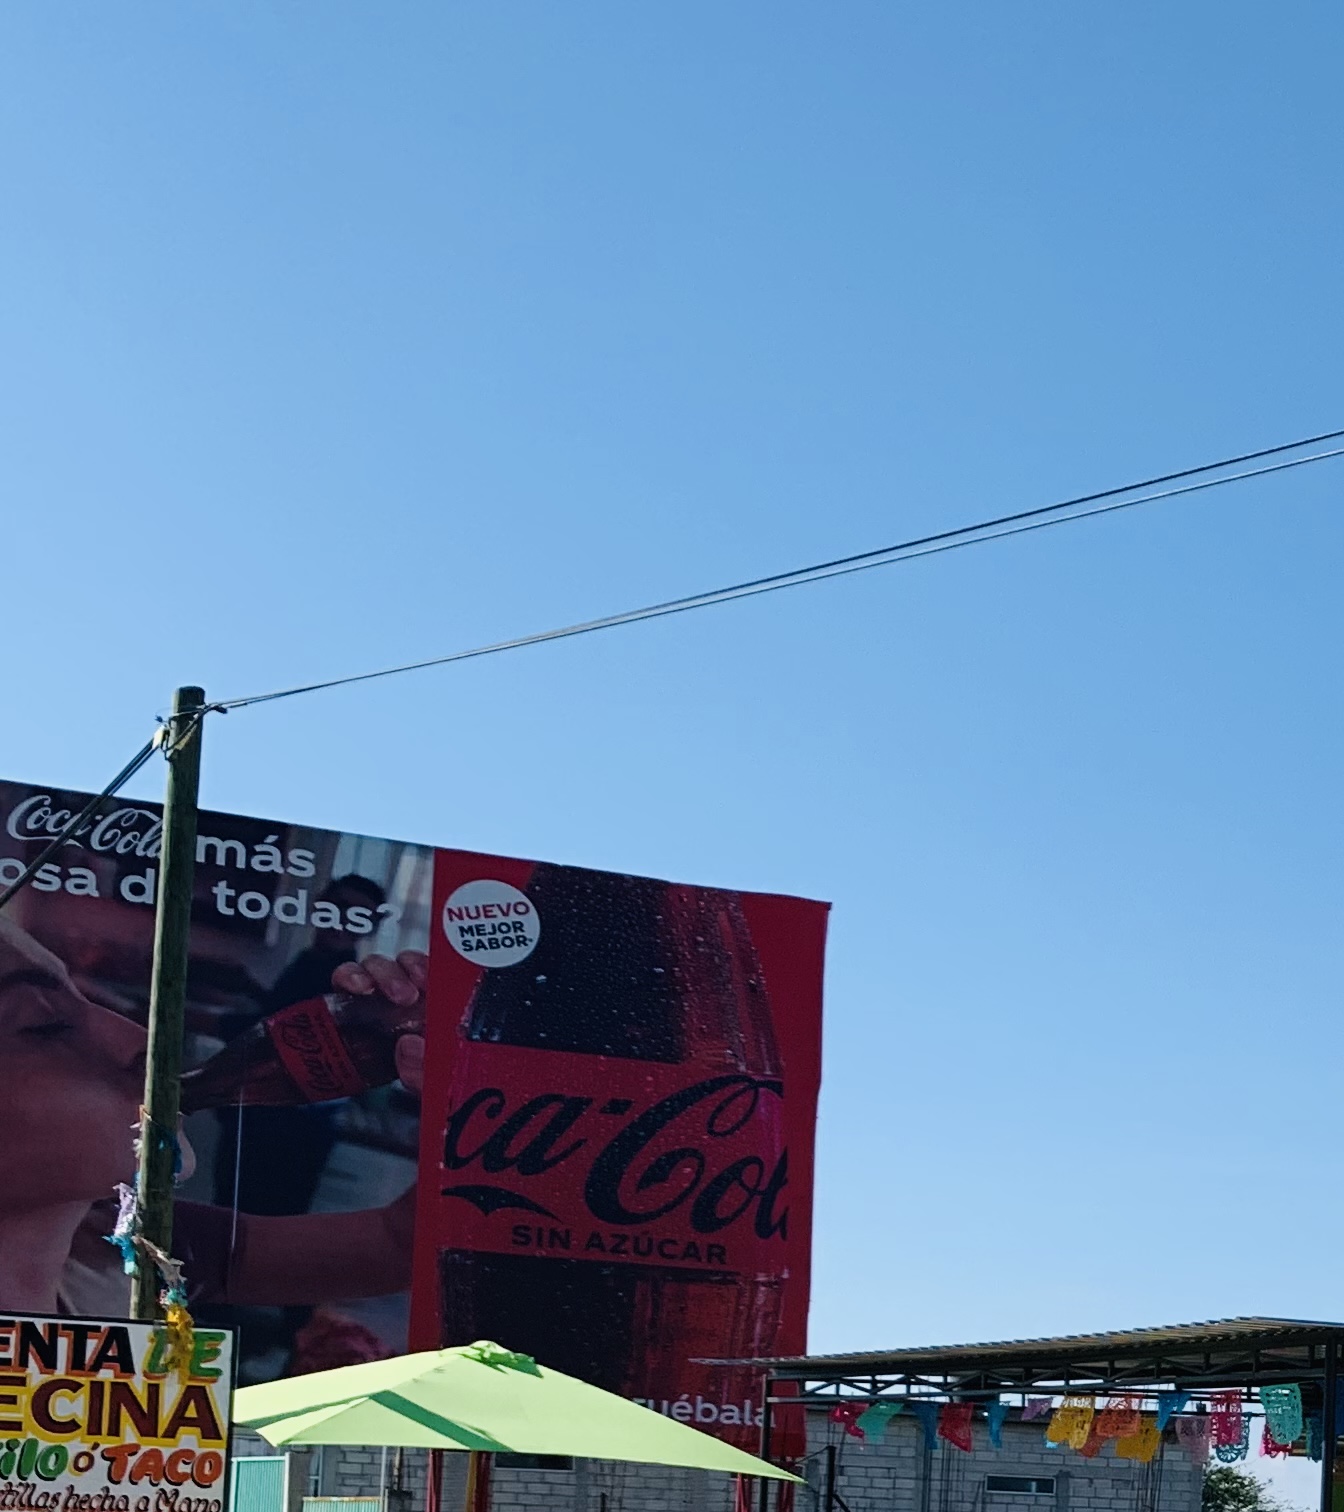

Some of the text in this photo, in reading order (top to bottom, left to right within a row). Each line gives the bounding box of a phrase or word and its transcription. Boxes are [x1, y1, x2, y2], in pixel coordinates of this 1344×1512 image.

[196, 834, 316, 878] más
[120, 868, 156, 905] d
[211, 878, 403, 935] todas?
[446, 901, 530, 922] NUEVO
[458, 921, 526, 938] MEJOR
[511, 1224, 728, 1265] SIN AZÚCAR
[0, 1375, 225, 1443] ECINA
[632, 1393, 776, 1428] uébala
[0, 1437, 69, 1481] ilo
[101, 1443, 224, 1489] TACO
[0, 1481, 62, 1512] tillas
